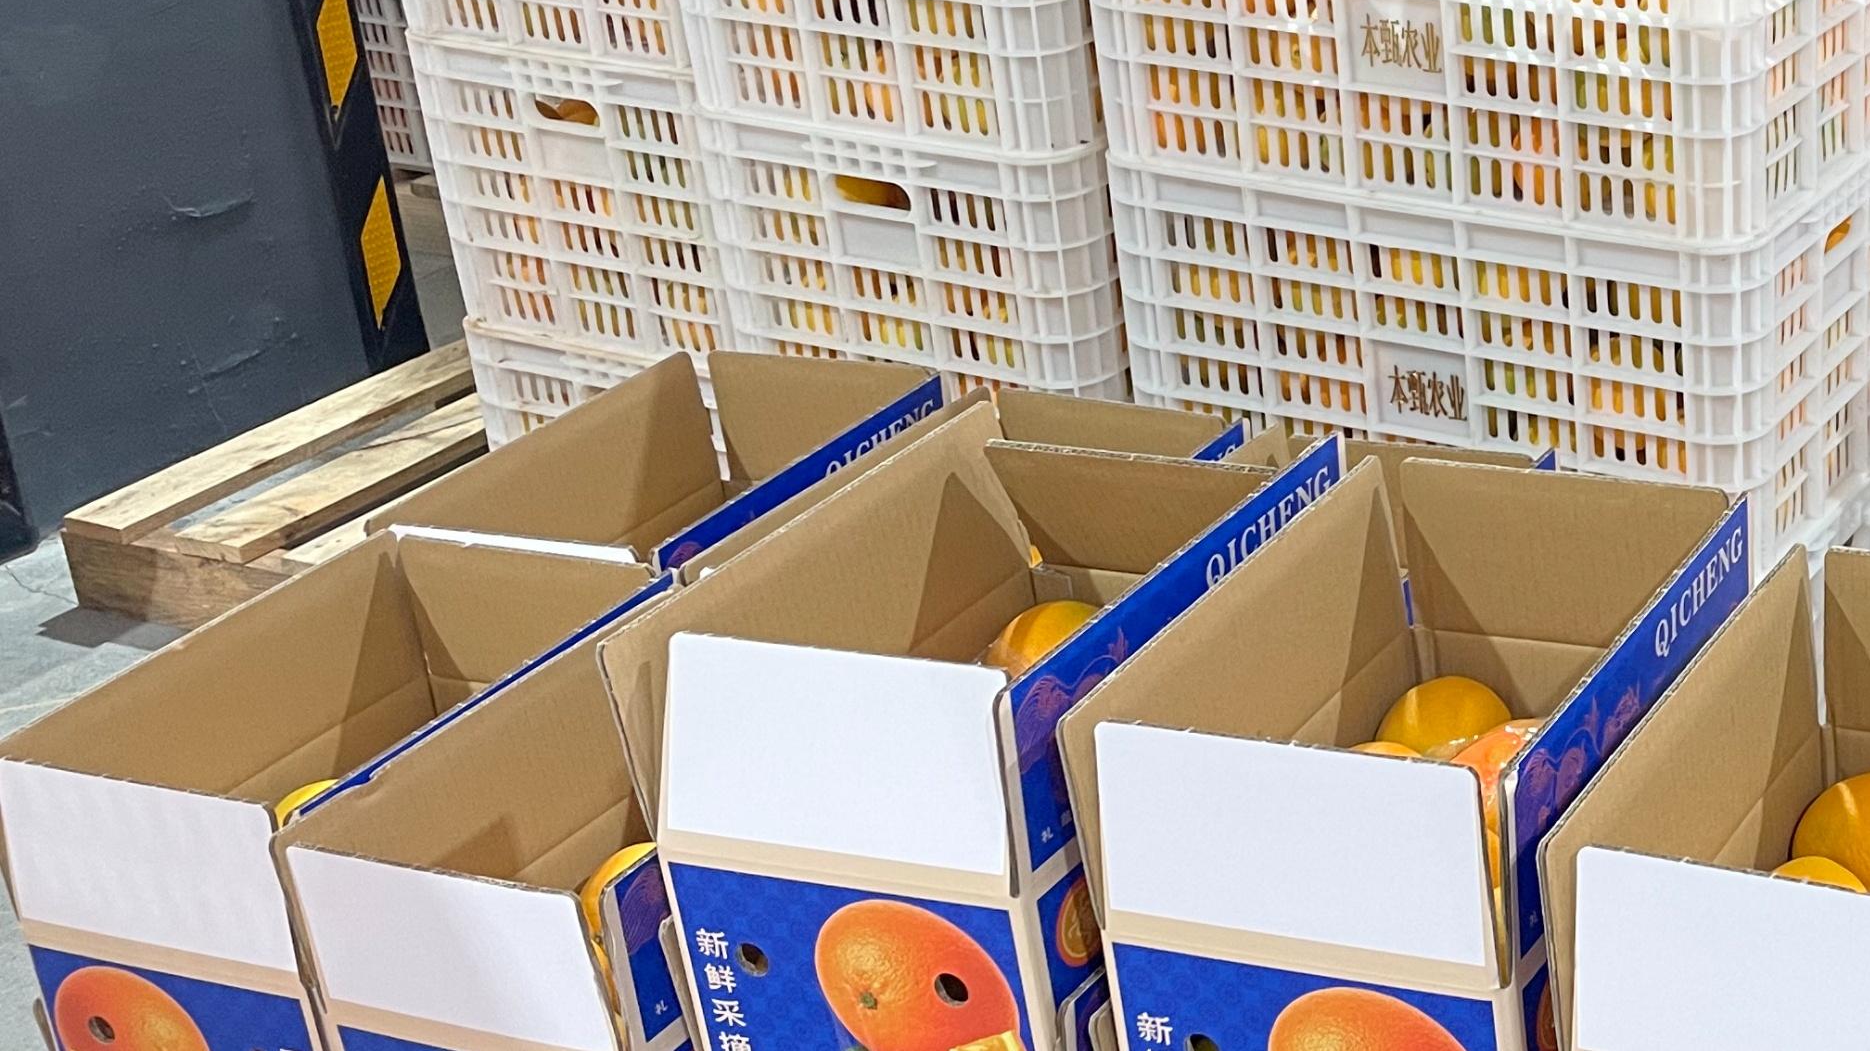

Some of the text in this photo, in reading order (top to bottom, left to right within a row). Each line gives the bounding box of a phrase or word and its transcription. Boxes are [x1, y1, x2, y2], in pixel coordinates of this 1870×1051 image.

[1360, 13, 1443, 75] 本甄农业
[1388, 364, 1468, 422] 本甄农业
[1203, 464, 1334, 591] QICHENG
[1653, 525, 1746, 659] QICHENG
[695, 927, 752, 1051] 新鲜采摘
[1136, 1011, 1174, 1051] 新
